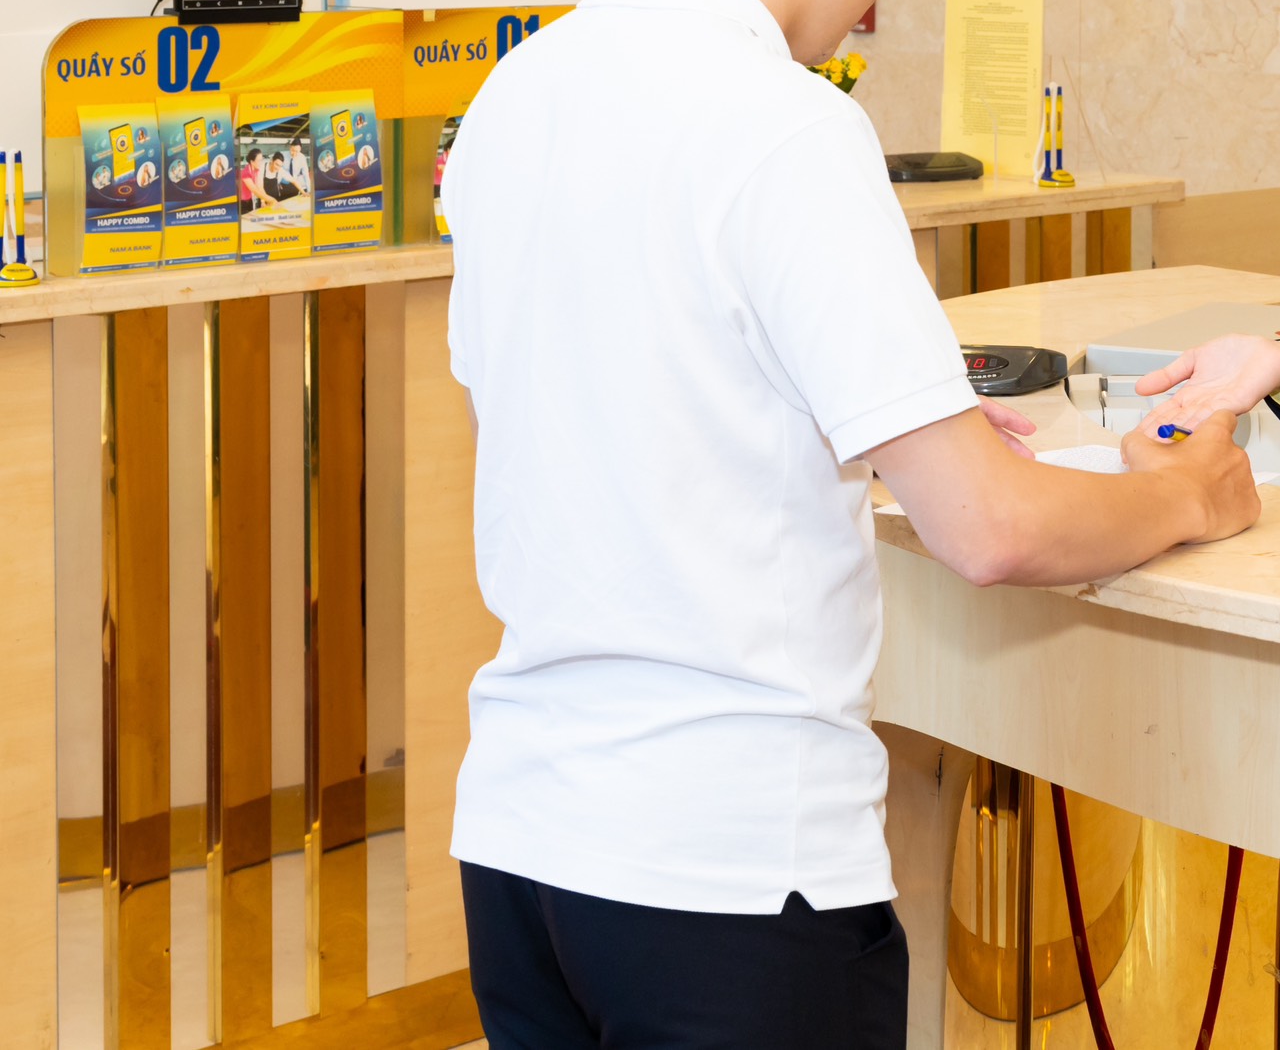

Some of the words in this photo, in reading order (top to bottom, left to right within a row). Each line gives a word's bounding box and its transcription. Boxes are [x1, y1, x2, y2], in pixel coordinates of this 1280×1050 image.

[466, 37, 488, 61] SỐ
[120, 49, 146, 76] SỐ
[157, 25, 221, 93] 02
[324, 198, 346, 207] HAPPY
[348, 197, 371, 205] COMBO
[176, 211, 200, 219] HAPPY
[201, 208, 226, 217] COMBO
[97, 217, 121, 226] HAPPY
[123, 216, 150, 225] COMBO
[279, 235, 299, 243] BANK
